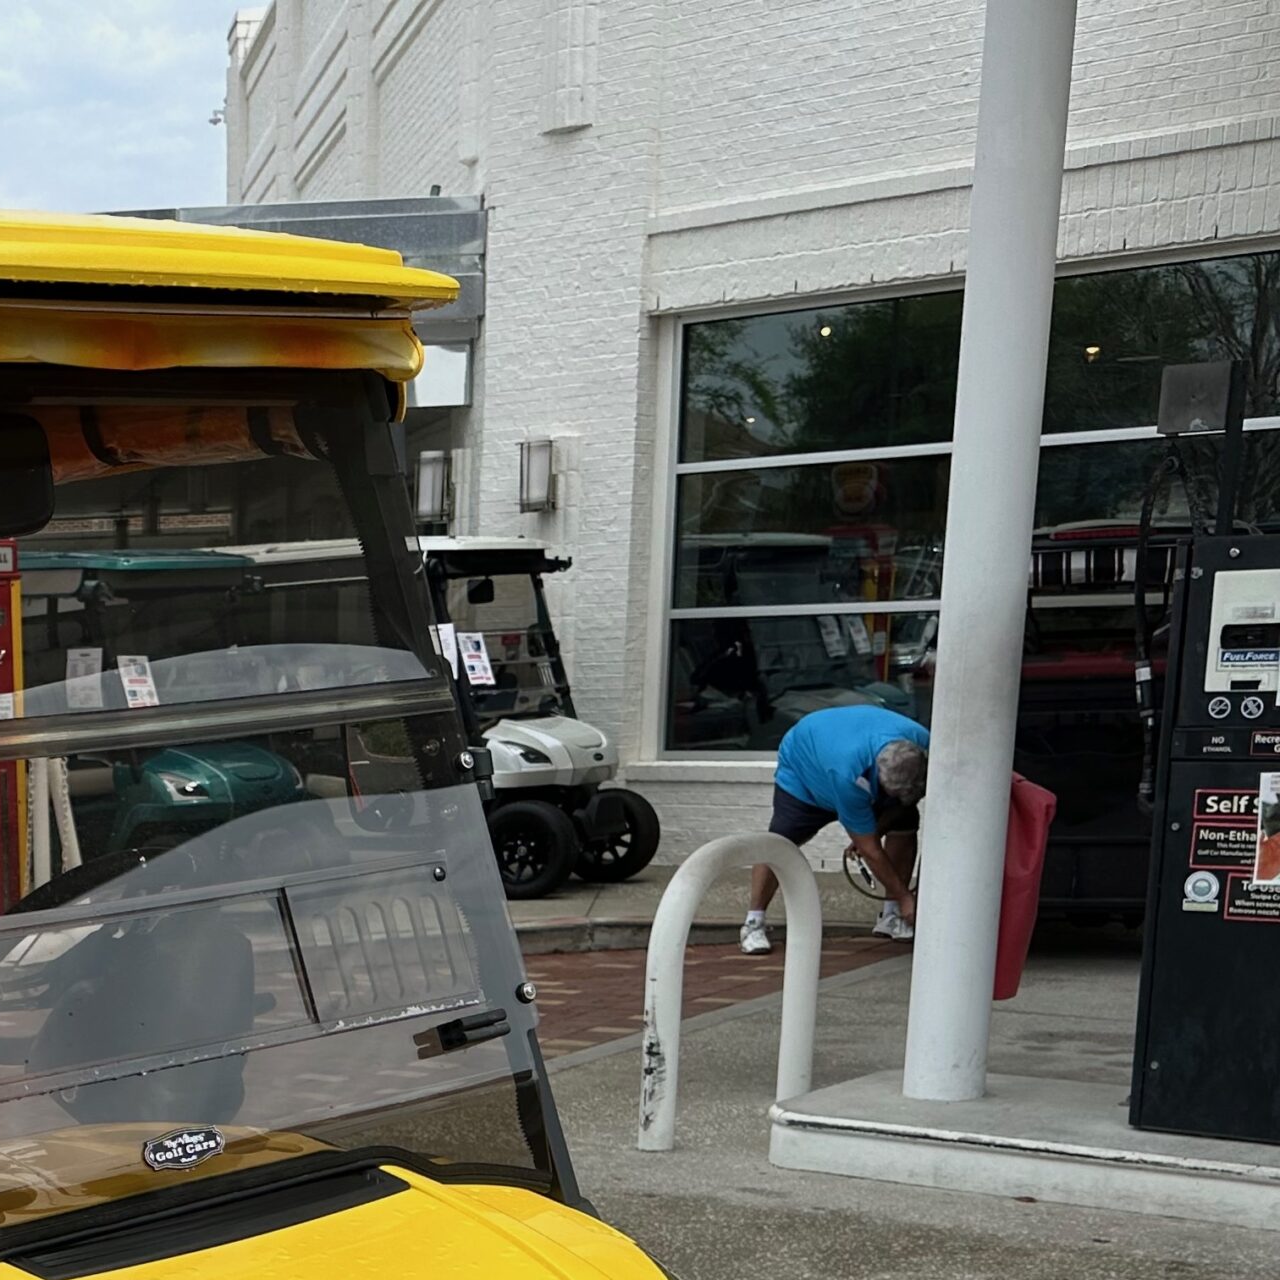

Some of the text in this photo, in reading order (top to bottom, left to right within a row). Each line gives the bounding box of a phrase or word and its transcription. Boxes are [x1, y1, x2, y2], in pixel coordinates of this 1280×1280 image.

[1211, 736, 1225, 744] NO
[1205, 795, 1250, 813] Self
[1199, 829, 1257, 841] Non-Etha
[155, 1139, 217, 1162] Golf Cars
